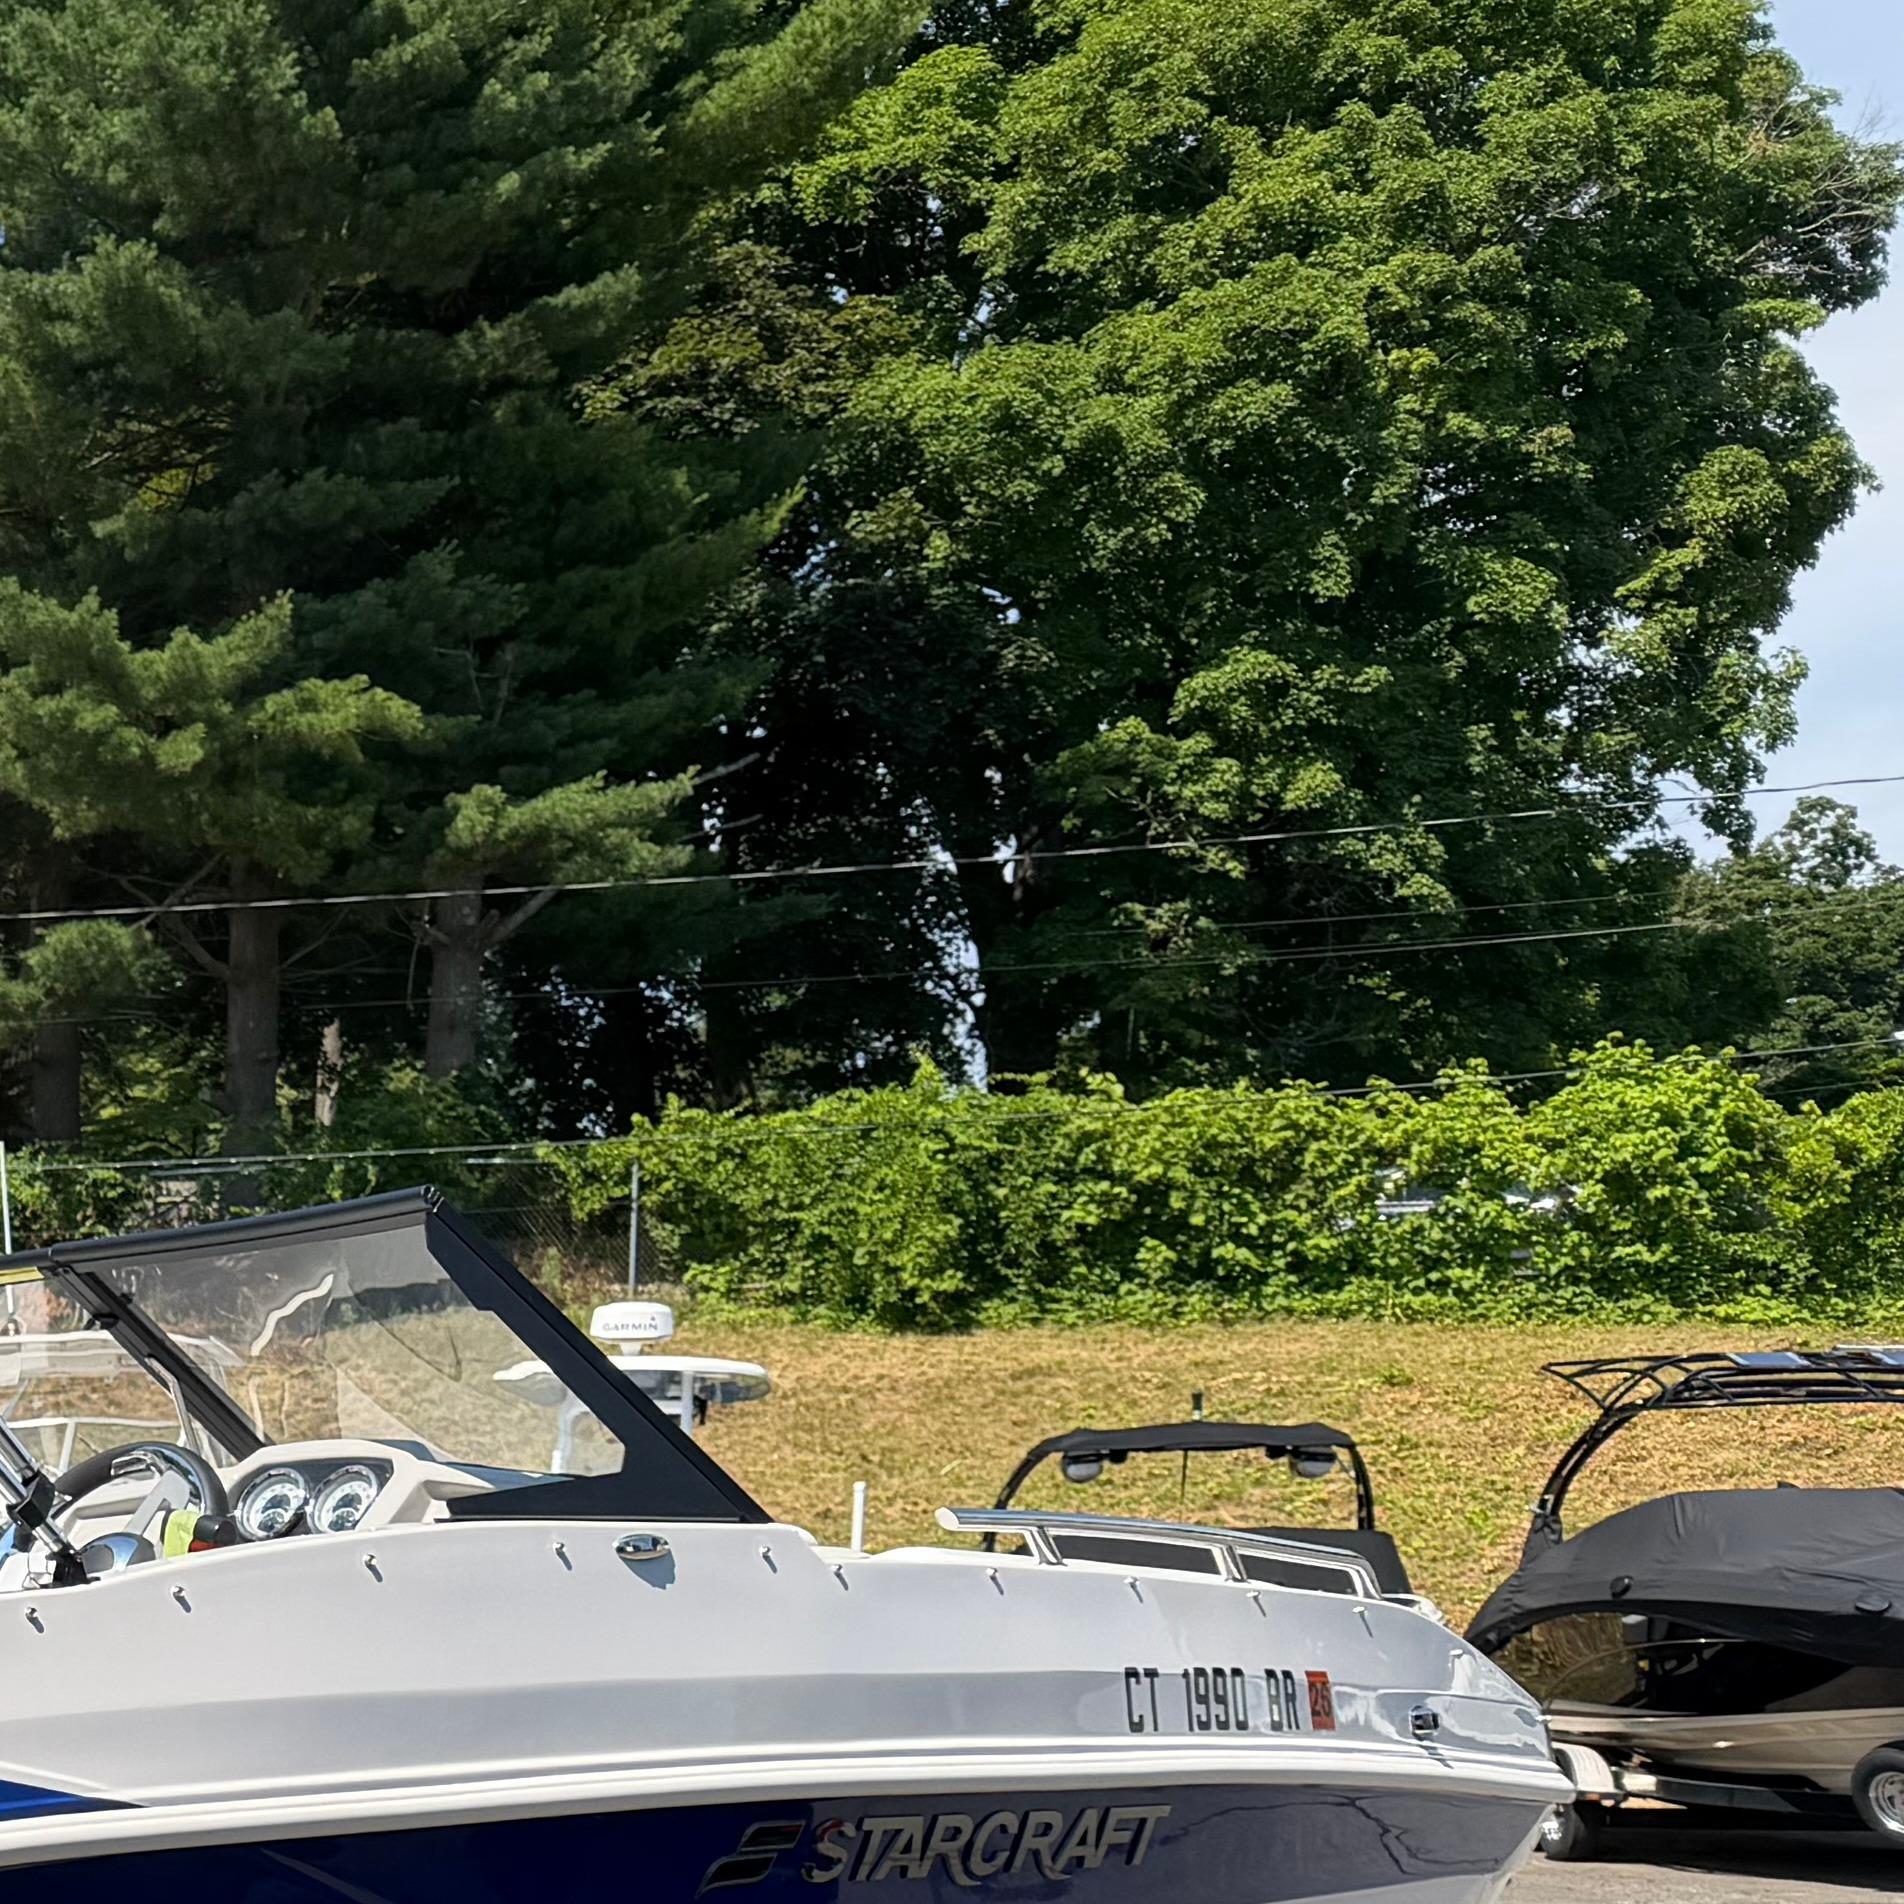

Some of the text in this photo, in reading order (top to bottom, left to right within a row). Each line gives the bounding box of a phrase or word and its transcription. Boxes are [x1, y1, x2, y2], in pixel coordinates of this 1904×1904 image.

[602, 1322, 658, 1332] GARMIN
[1124, 1667, 1159, 1733] CT
[1182, 1667, 1249, 1732] 1990
[800, 1805, 1172, 1887] STARCRAFT
